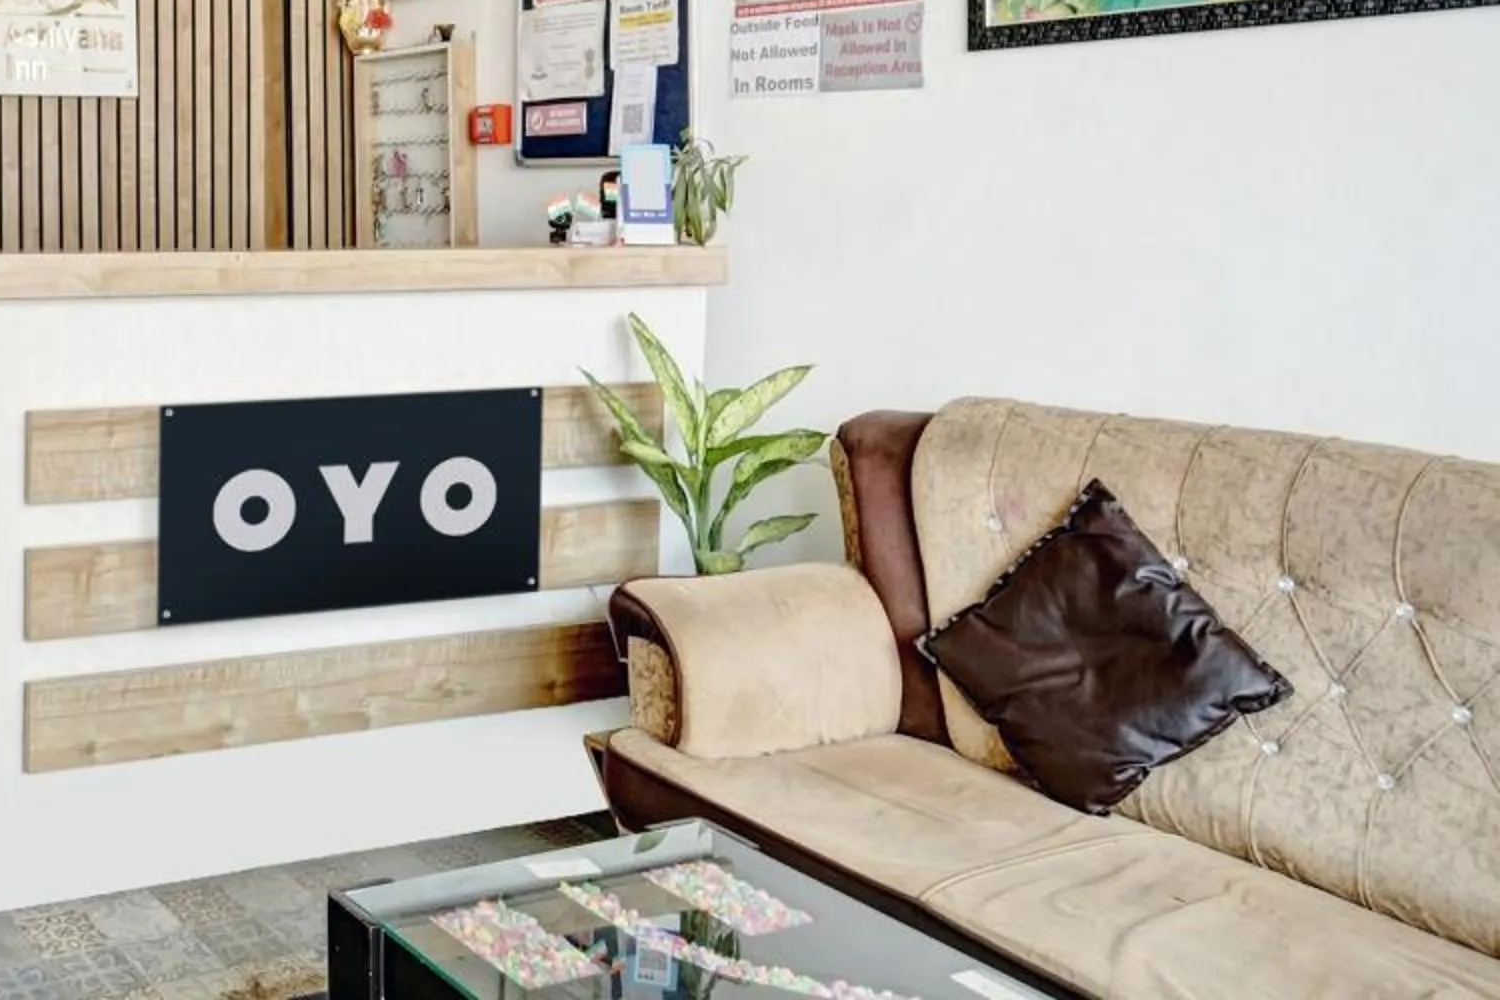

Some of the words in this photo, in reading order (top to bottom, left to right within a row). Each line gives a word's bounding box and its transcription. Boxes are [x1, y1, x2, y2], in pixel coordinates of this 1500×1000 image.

[730, 18, 781, 35] Outside
[785, 12, 820, 29] Food
[825, 21, 860, 37] Mask
[876, 18, 901, 33] Not
[730, 47, 756, 62] Not
[759, 42, 818, 60] Allowed
[840, 40, 890, 56] Allowed
[5, 52, 48, 81] Inn
[825, 61, 890, 79] Reception
[891, 58, 922, 74] Area
[734, 77, 750, 94] In
[755, 74, 815, 93] Rooms
[212, 455, 498, 552] OYO
